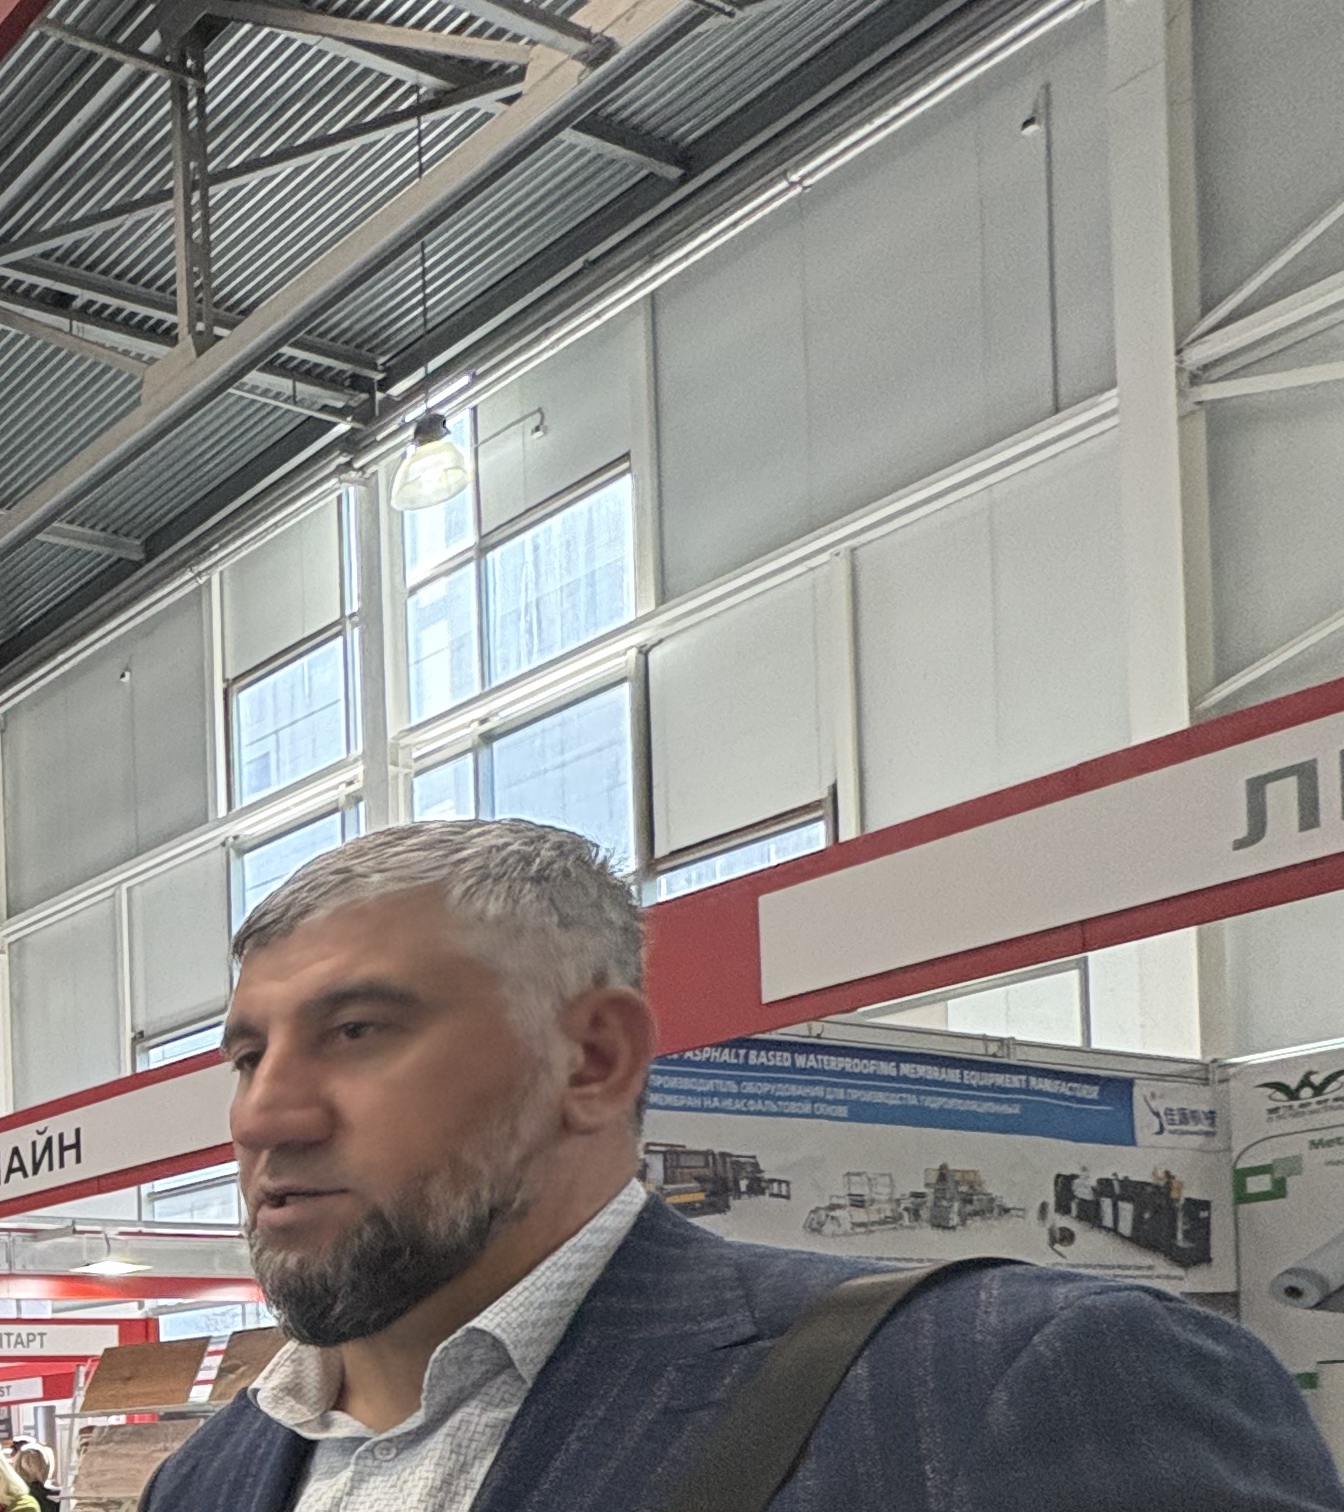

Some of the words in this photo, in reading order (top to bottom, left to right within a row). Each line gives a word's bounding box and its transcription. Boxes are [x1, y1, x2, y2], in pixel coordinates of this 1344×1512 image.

[1232, 750, 1344, 852] Л
[748, 1050, 791, 1067] BASED
[794, 1053, 897, 1076] WATERPROOFING
